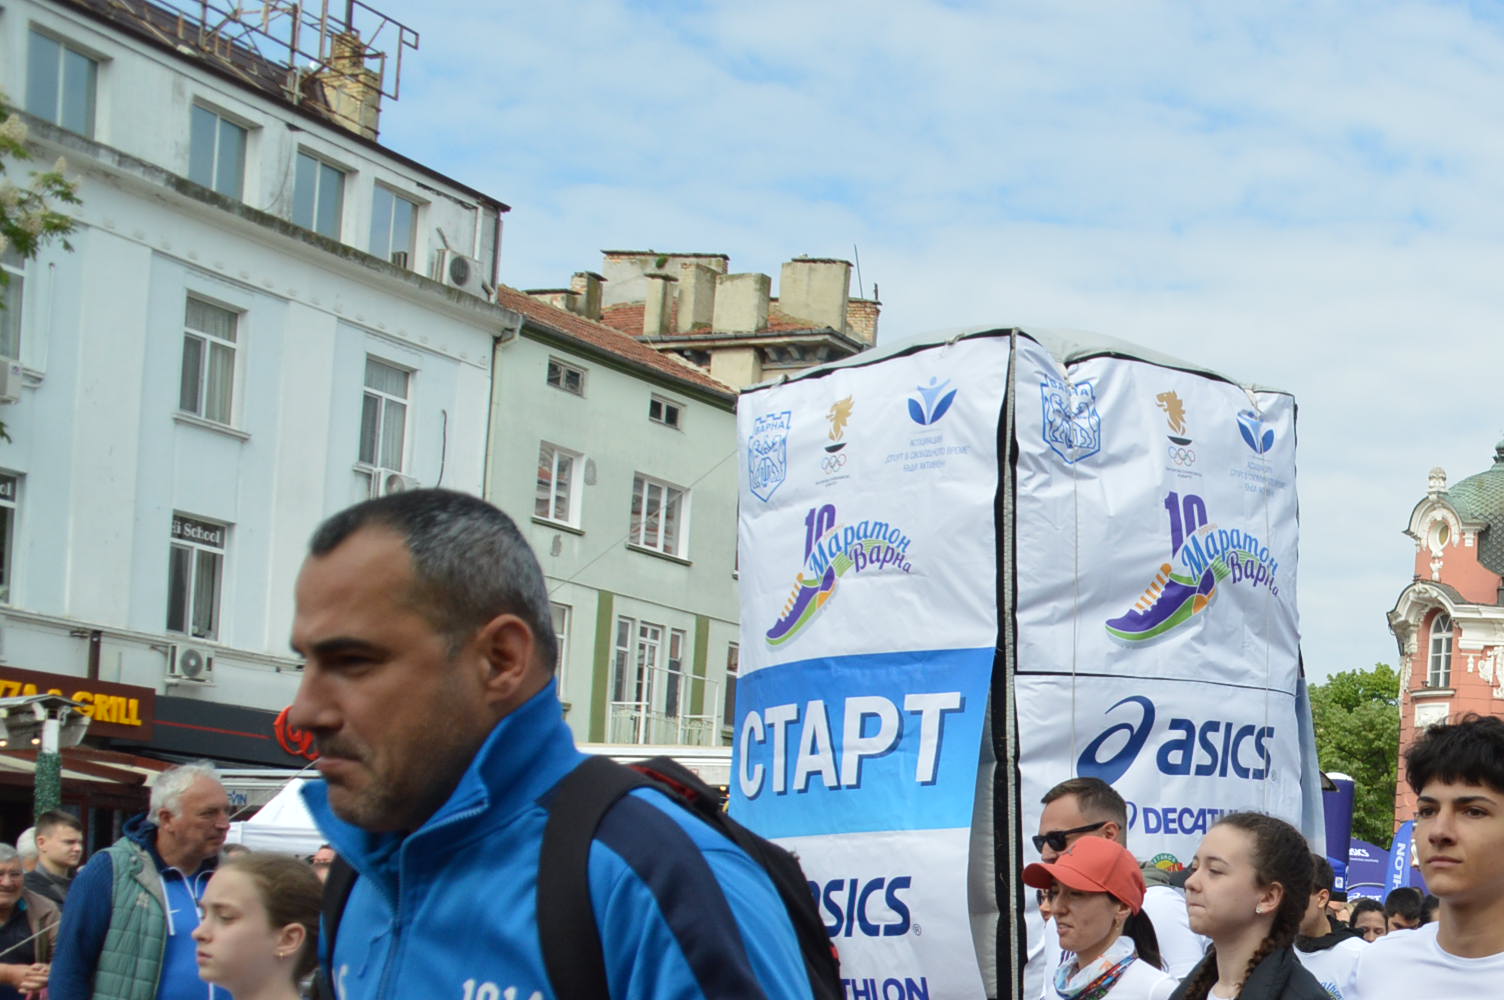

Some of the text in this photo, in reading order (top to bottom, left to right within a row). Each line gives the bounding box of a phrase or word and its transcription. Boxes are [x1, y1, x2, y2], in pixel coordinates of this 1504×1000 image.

[803, 504, 836, 567] 10
[809, 519, 912, 584] Маратон
[848, 542, 912, 573] Варна
[1164, 491, 1208, 560] 10
[72, 691, 142, 726] GRILL
[739, 691, 964, 800] СТАРТ
